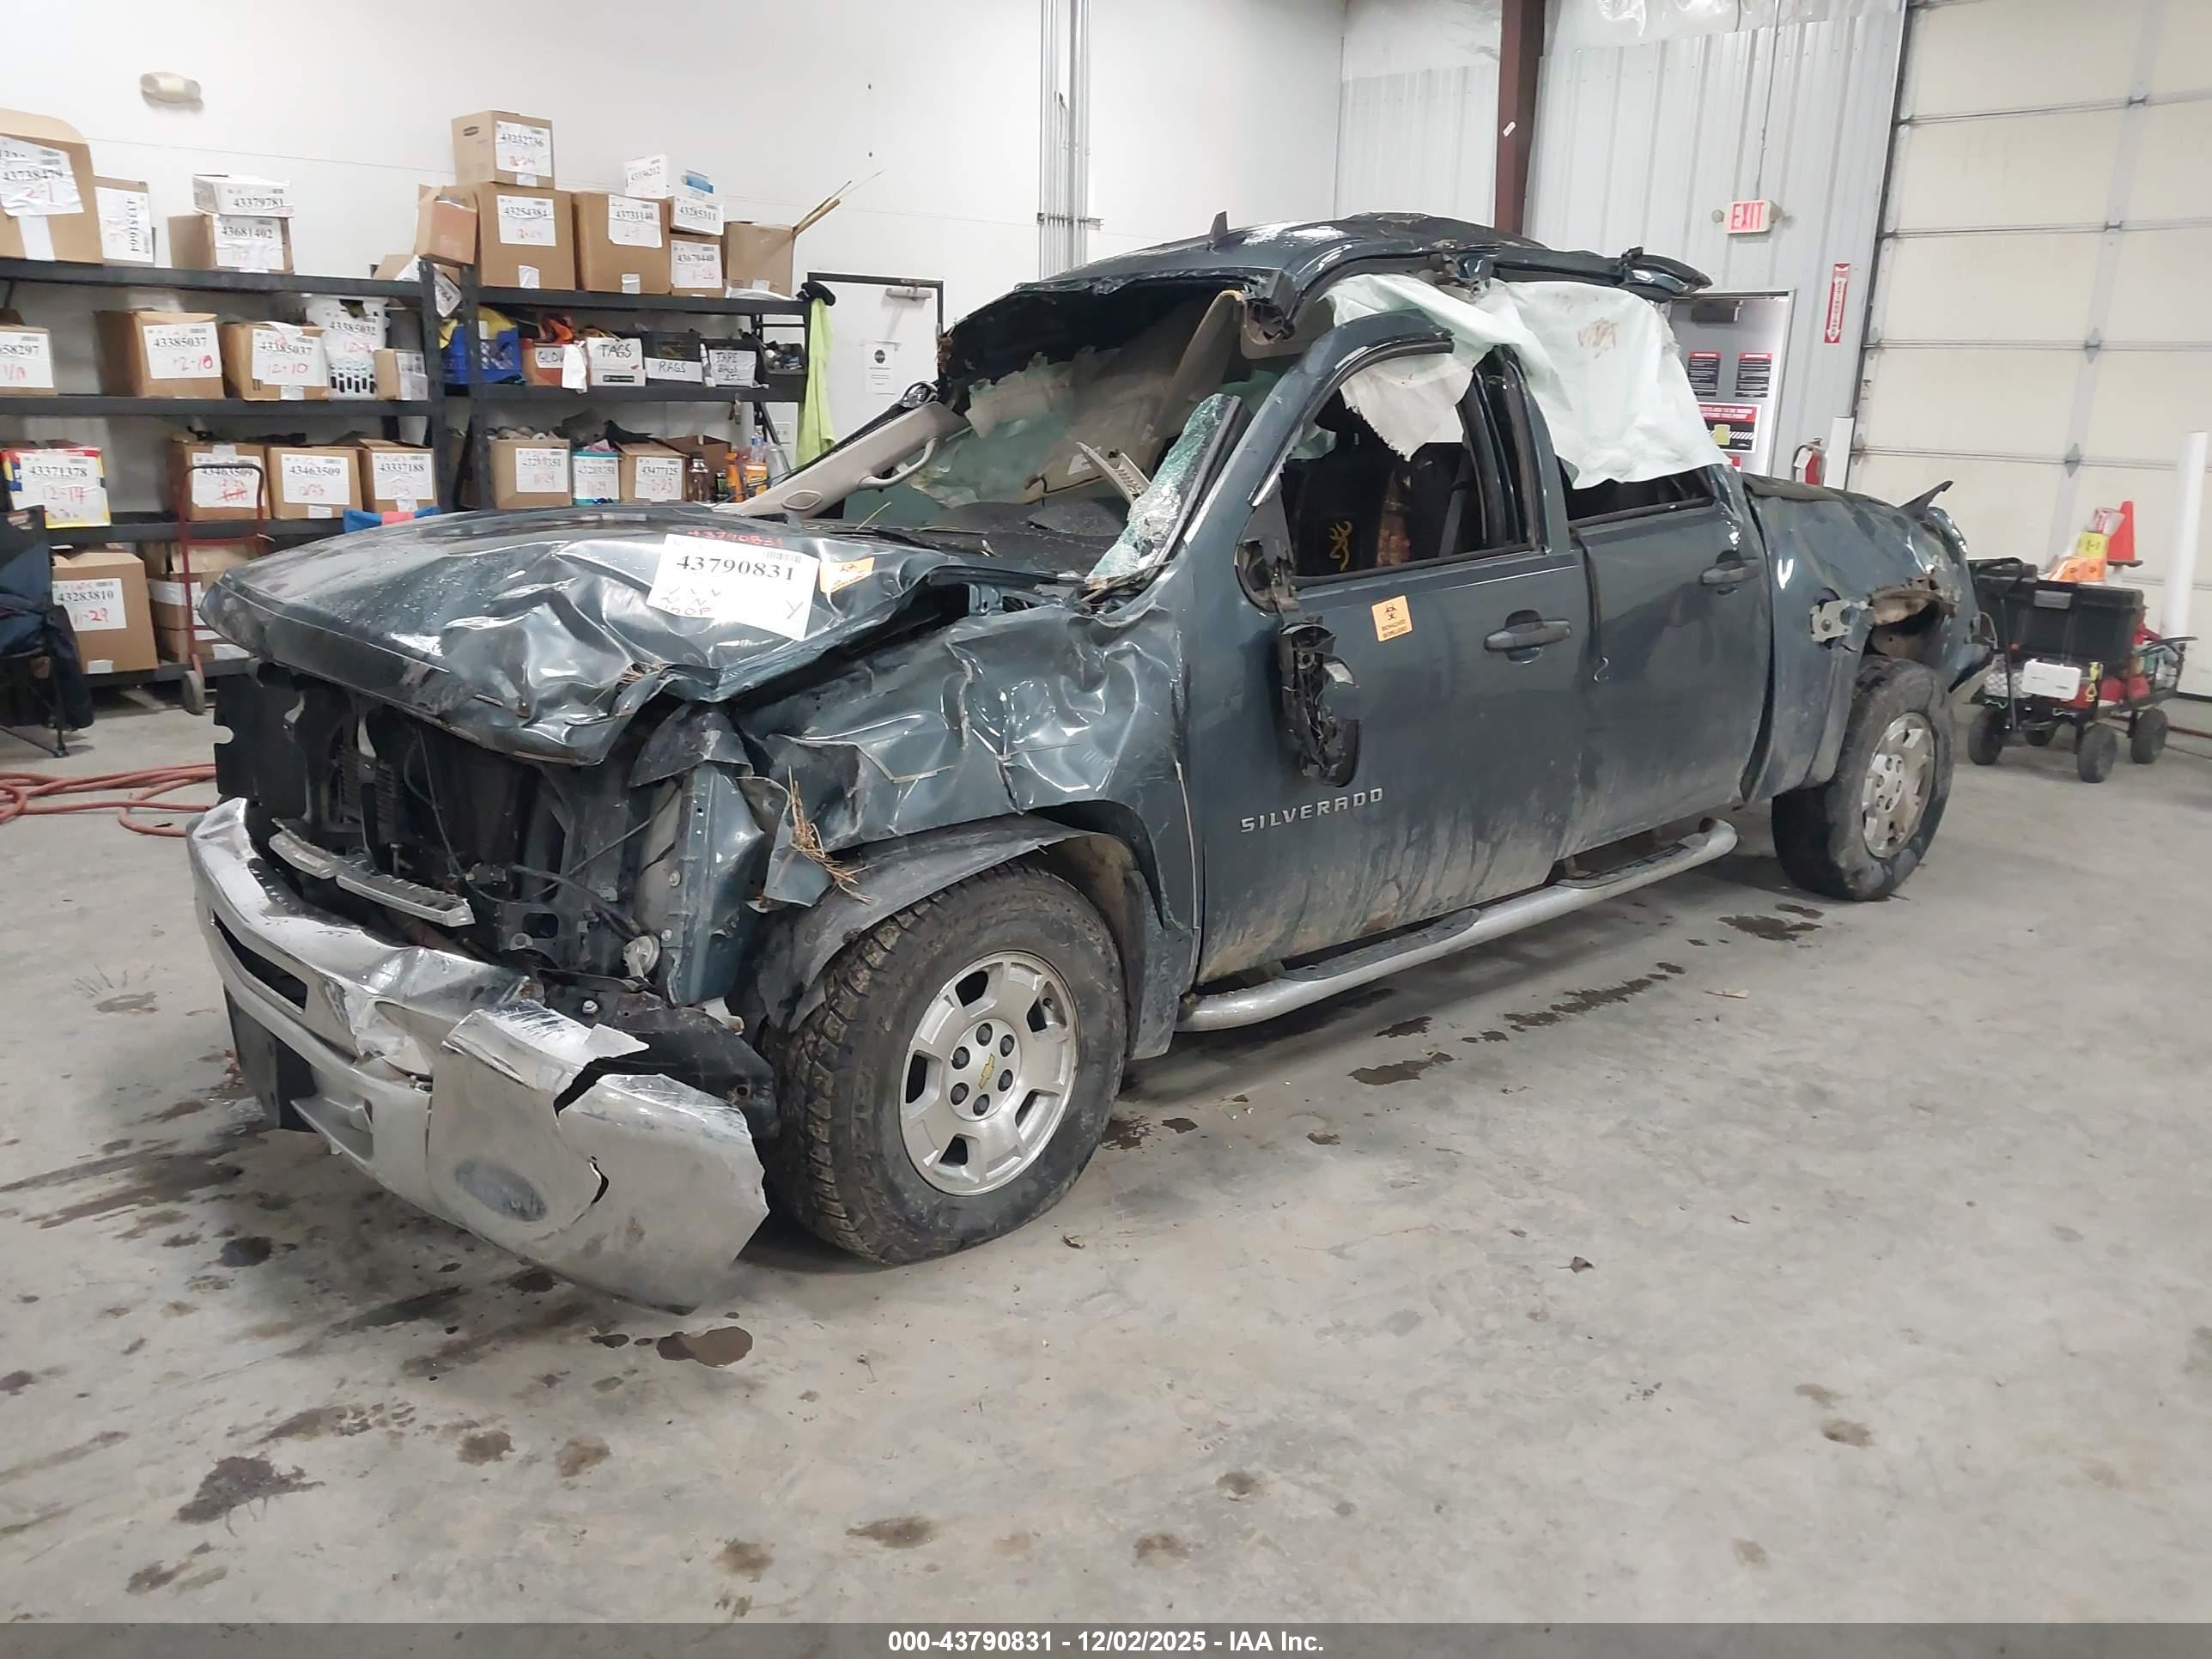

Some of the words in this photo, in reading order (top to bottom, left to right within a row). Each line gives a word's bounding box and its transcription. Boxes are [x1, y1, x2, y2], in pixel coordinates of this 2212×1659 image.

[233, 198, 283, 207] 43379781
[1731, 202, 1765, 229] EXIT
[221, 226, 274, 240] 43681402
[153, 337, 208, 348] 43385037
[601, 343, 633, 359] TAGS
[659, 359, 687, 374] RAGS
[289, 465, 342, 476] 43463509
[379, 463, 426, 472] 43337188
[676, 555, 794, 581] 43790831
[1241, 787, 1384, 834] SILVERADO
